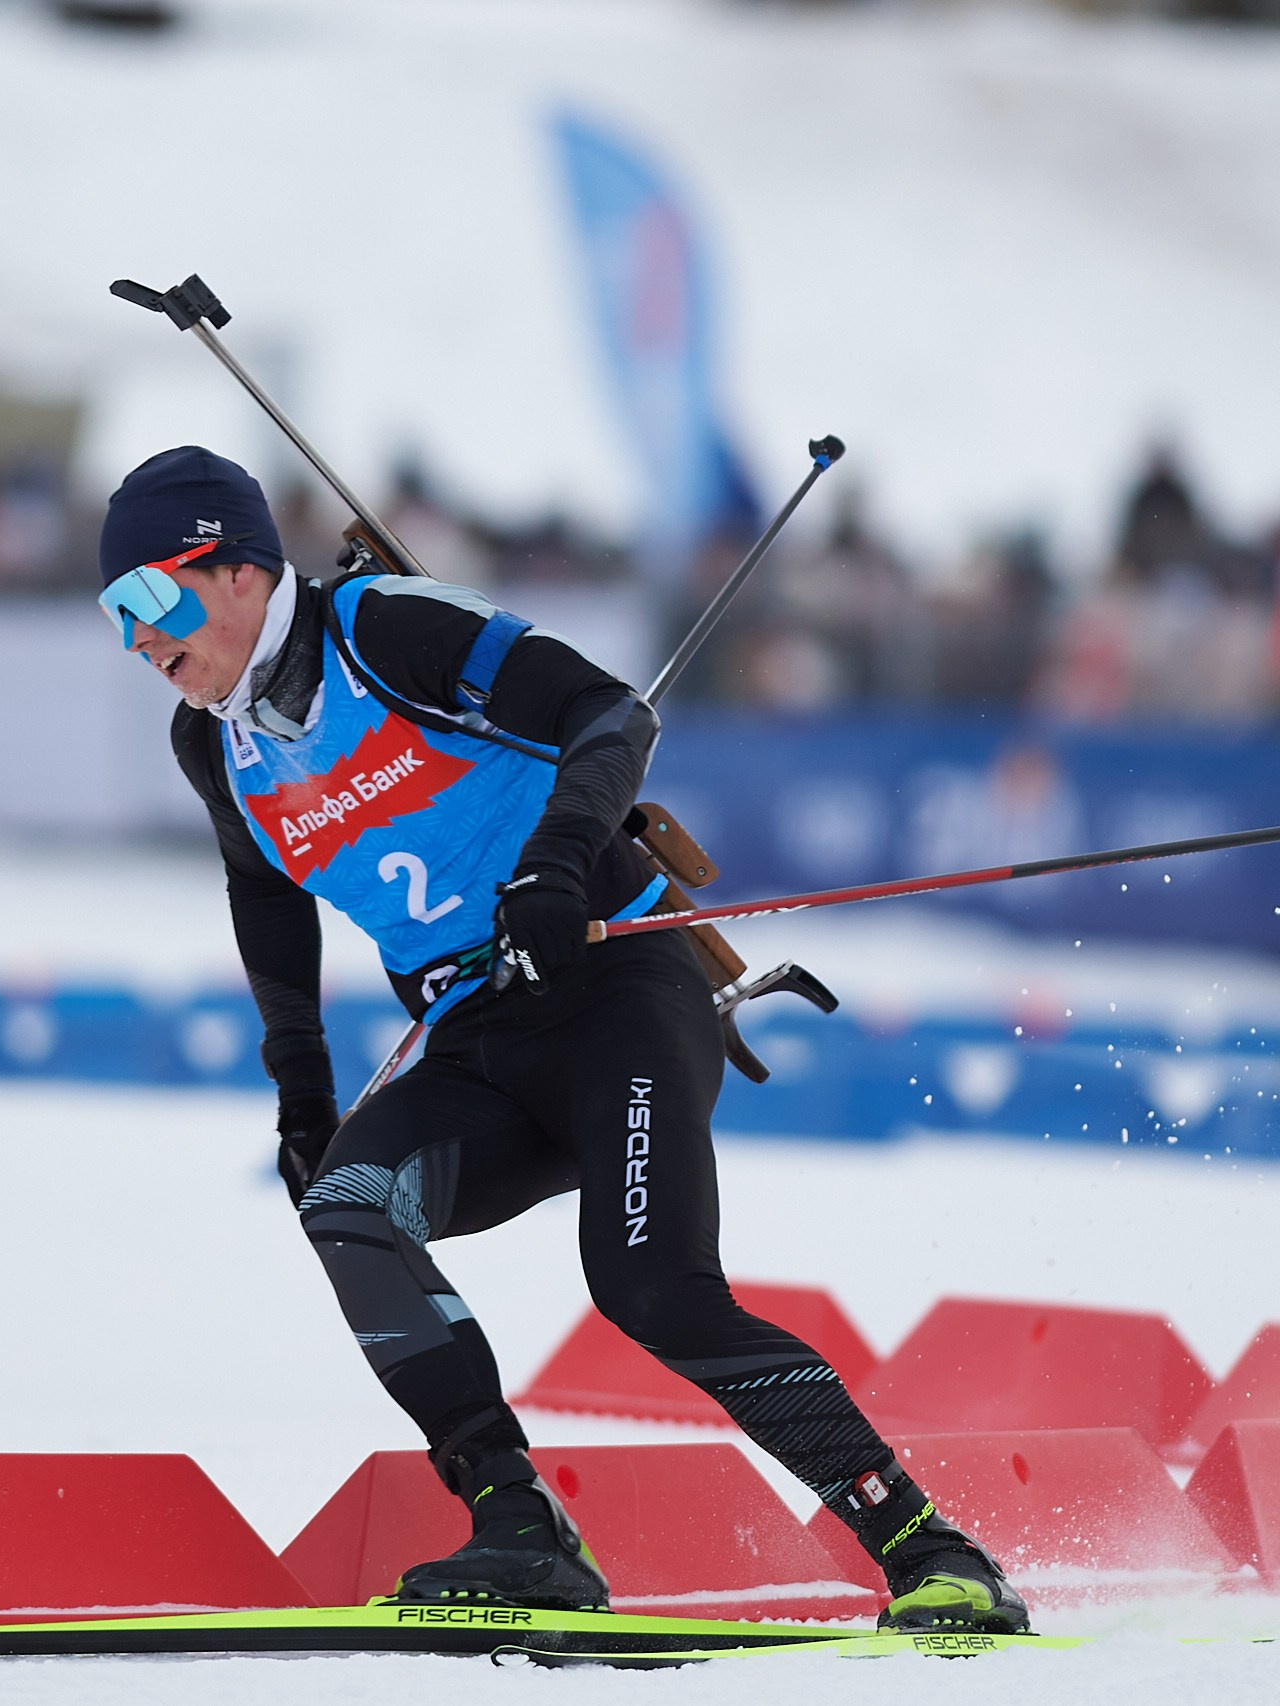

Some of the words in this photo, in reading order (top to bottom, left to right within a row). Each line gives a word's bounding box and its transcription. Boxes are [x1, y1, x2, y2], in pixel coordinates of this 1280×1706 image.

[280, 794, 361, 846] Альфа
[350, 747, 425, 802] Банк
[377, 851, 464, 924] 2
[625, 1077, 653, 1248] NORDSKI
[398, 1608, 532, 1624] FISCHER
[913, 1636, 997, 1650] FISCHER
